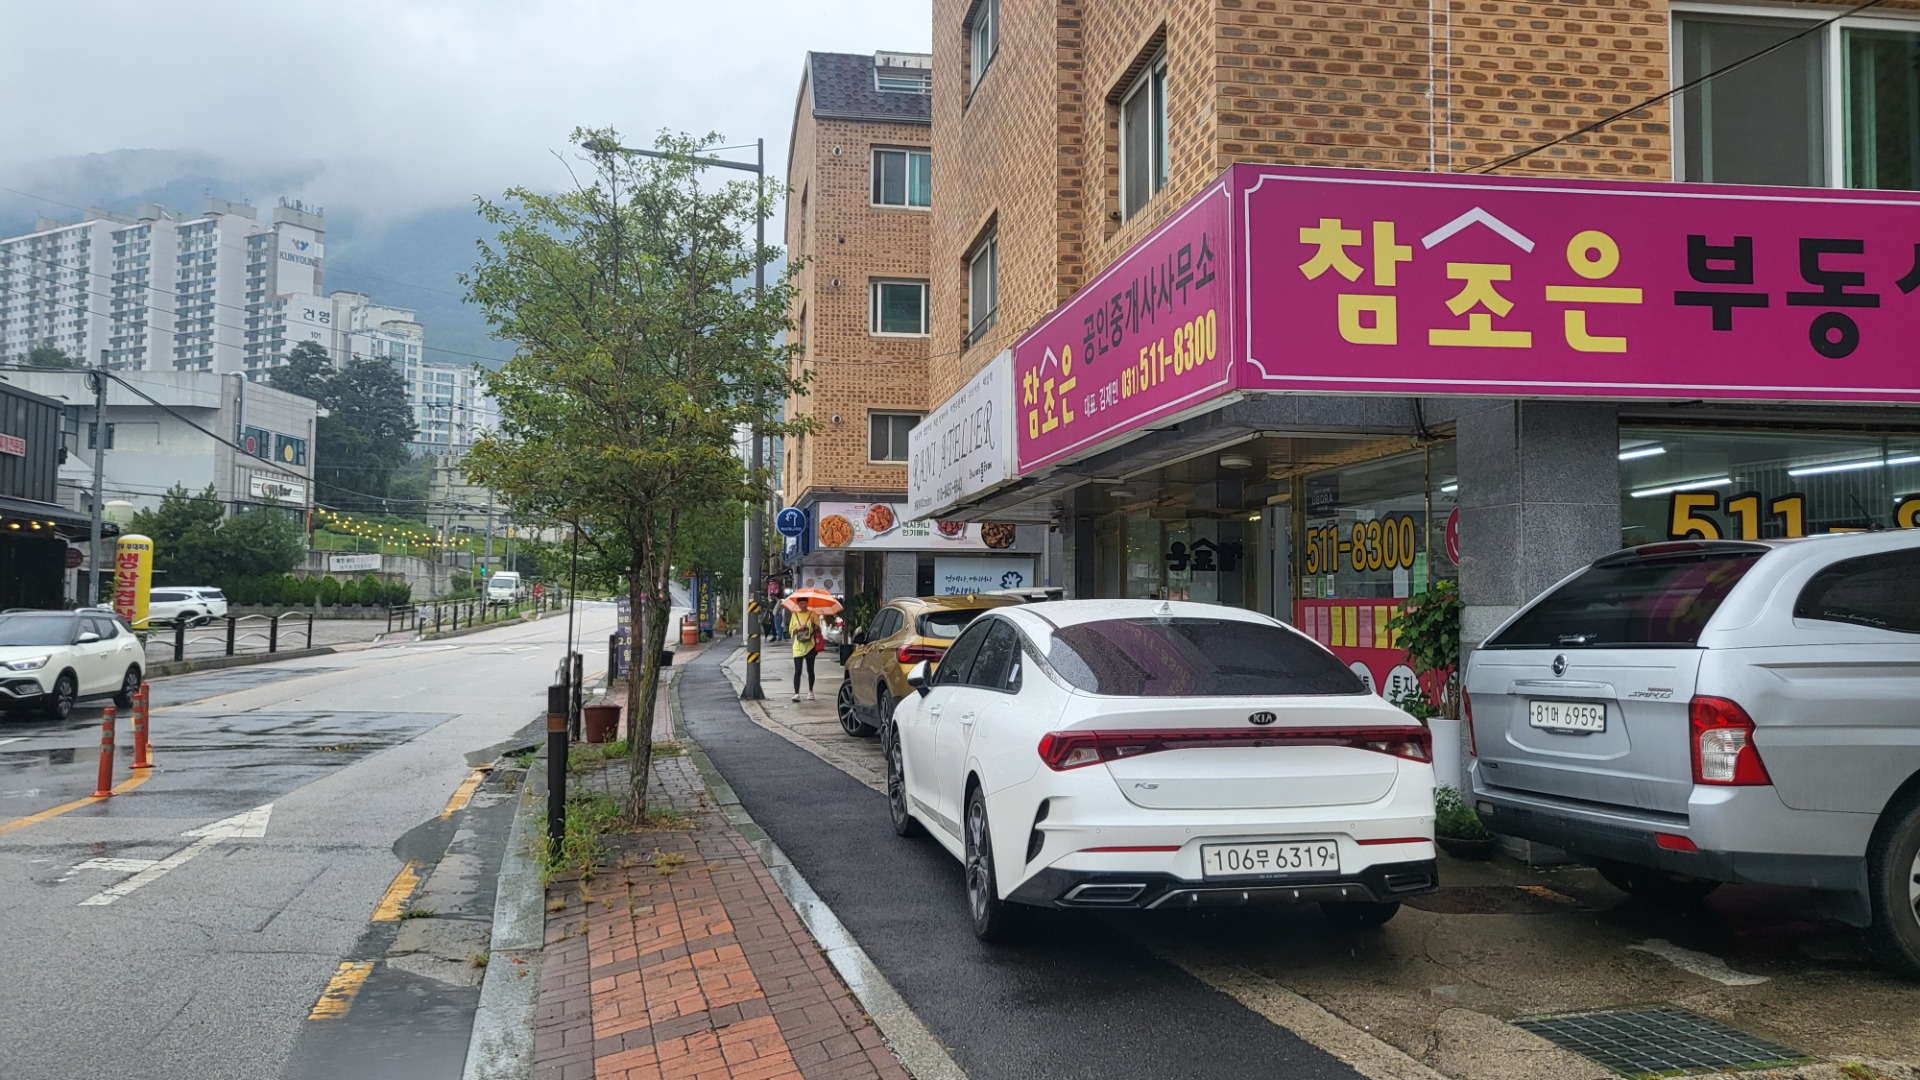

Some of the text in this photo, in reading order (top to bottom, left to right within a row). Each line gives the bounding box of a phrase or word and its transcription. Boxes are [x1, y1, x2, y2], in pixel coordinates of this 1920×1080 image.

[279, 250, 319, 267] KUNYOUNG
[1298, 207, 1920, 359] 참조은 부동
[1083, 232, 1215, 364] 공인중개사사무소
[303, 308, 330, 323] 건영
[311, 331, 321, 339] 101
[1023, 344, 1077, 439] 참조은
[913, 441, 937, 491] RANI
[939, 400, 995, 478] ATELIER
[902, 529, 930, 537] 인기메뉴
[1306, 516, 1415, 575] 511-8300
[1253, 713, 1272, 723] KIA
[1134, 782, 1159, 790] K5
